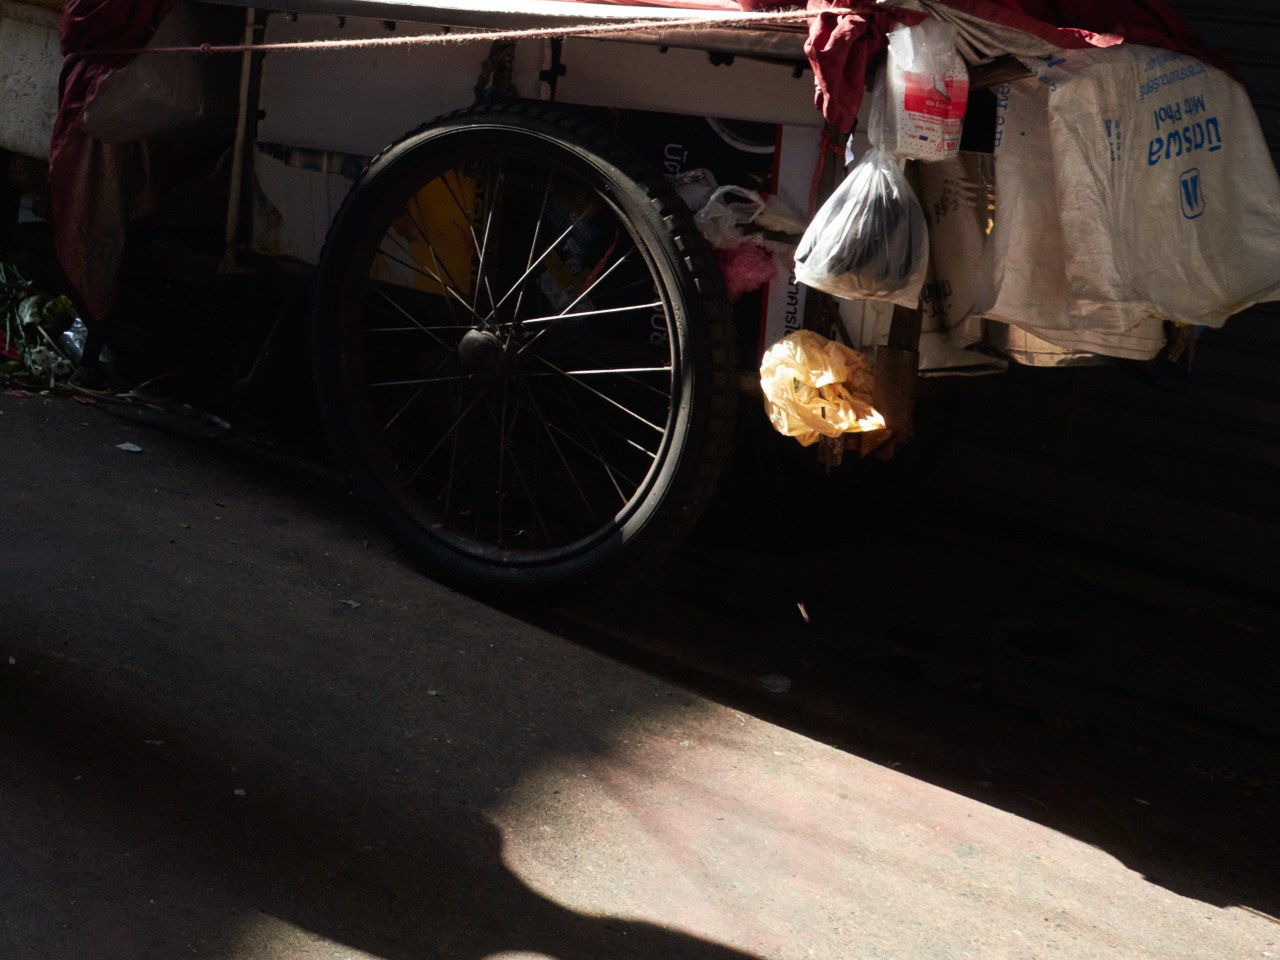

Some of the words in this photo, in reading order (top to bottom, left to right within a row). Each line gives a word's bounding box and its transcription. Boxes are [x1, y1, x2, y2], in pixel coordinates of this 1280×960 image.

[1154, 102, 1181, 130] Phol
[1184, 94, 1205, 117] Mitr
[1149, 117, 1222, 166] มิตรผล
